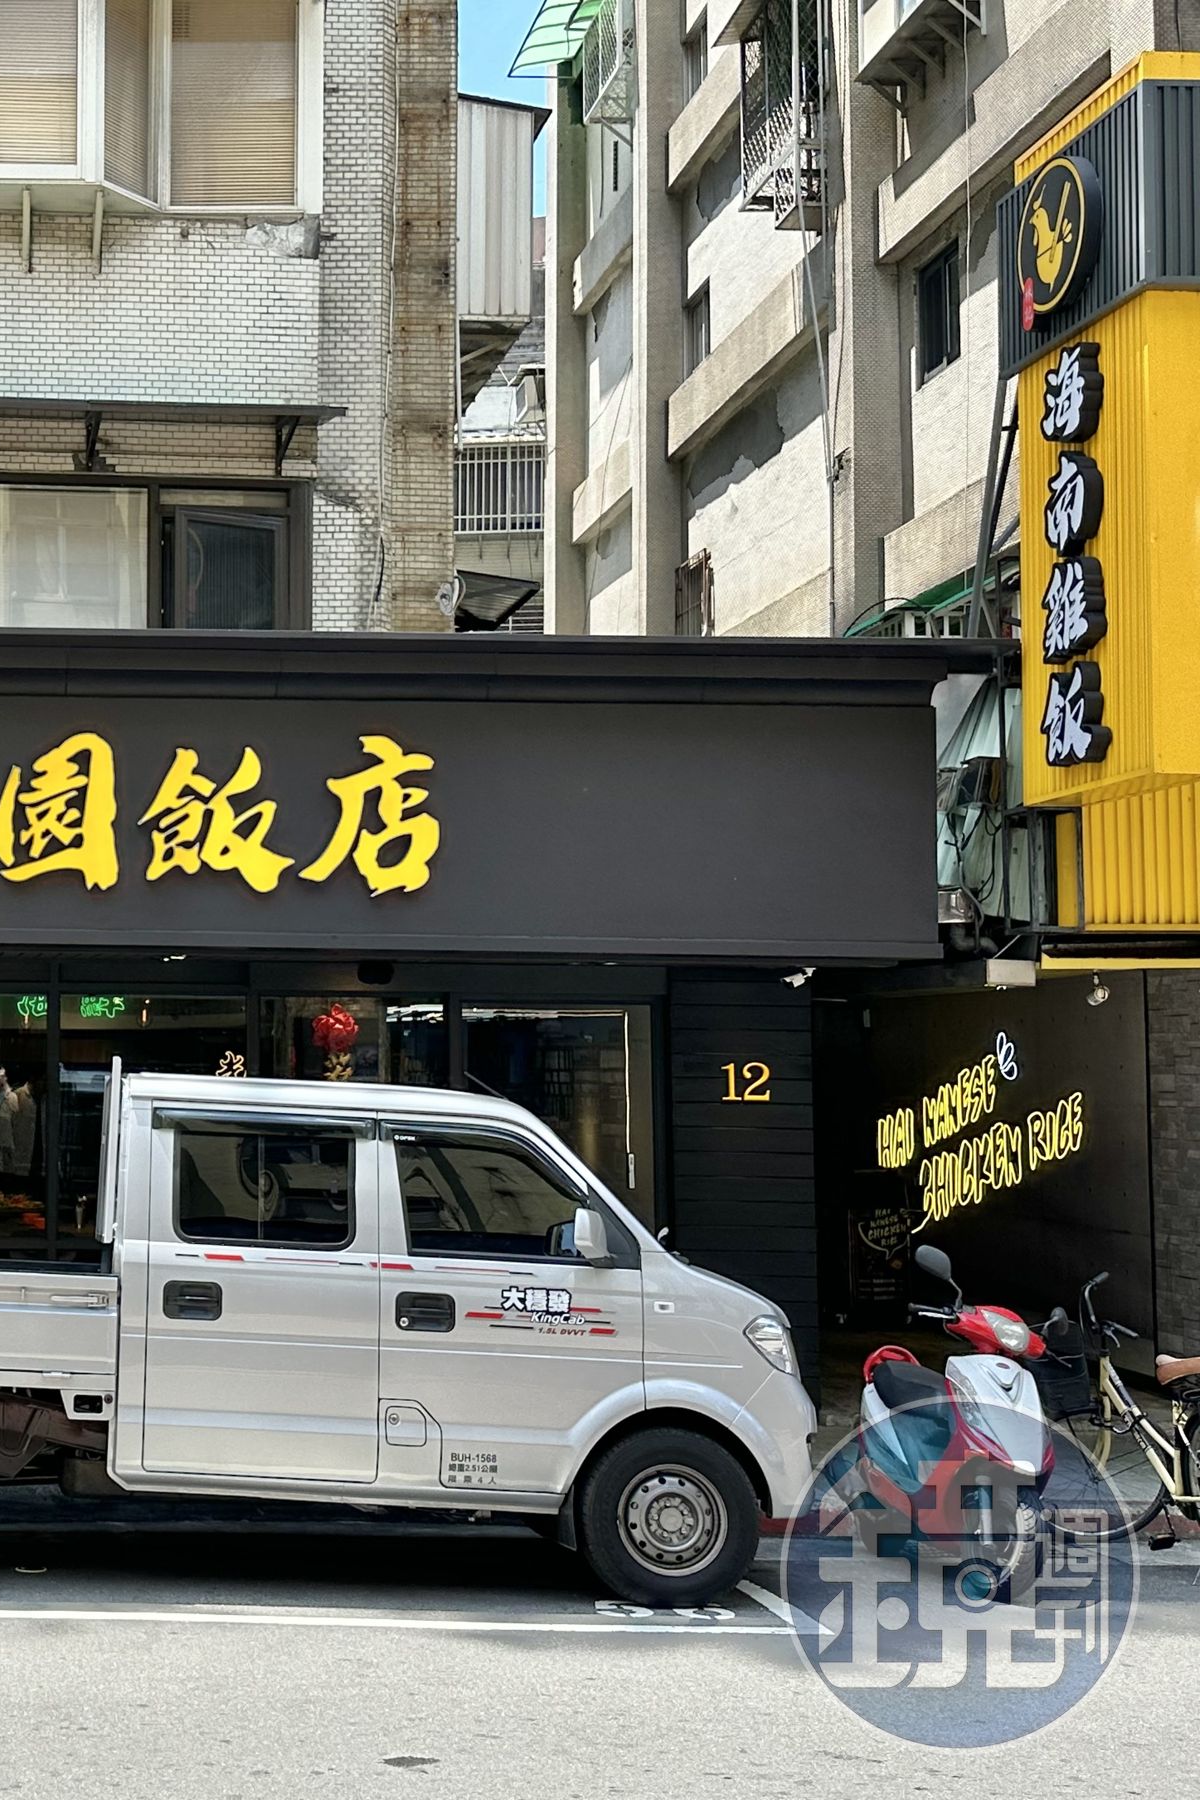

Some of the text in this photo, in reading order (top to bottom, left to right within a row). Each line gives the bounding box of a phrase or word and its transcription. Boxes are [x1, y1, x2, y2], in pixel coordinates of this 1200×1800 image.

[721, 1062, 771, 1101] 12
[878, 1108, 915, 1168] HAI
[916, 1092, 1083, 1226] CHICKEN RICE
[530, 1312, 585, 1325] KingCab
[560, 1328, 586, 1336] DVVT
[450, 1452, 497, 1463] BUH-1568
